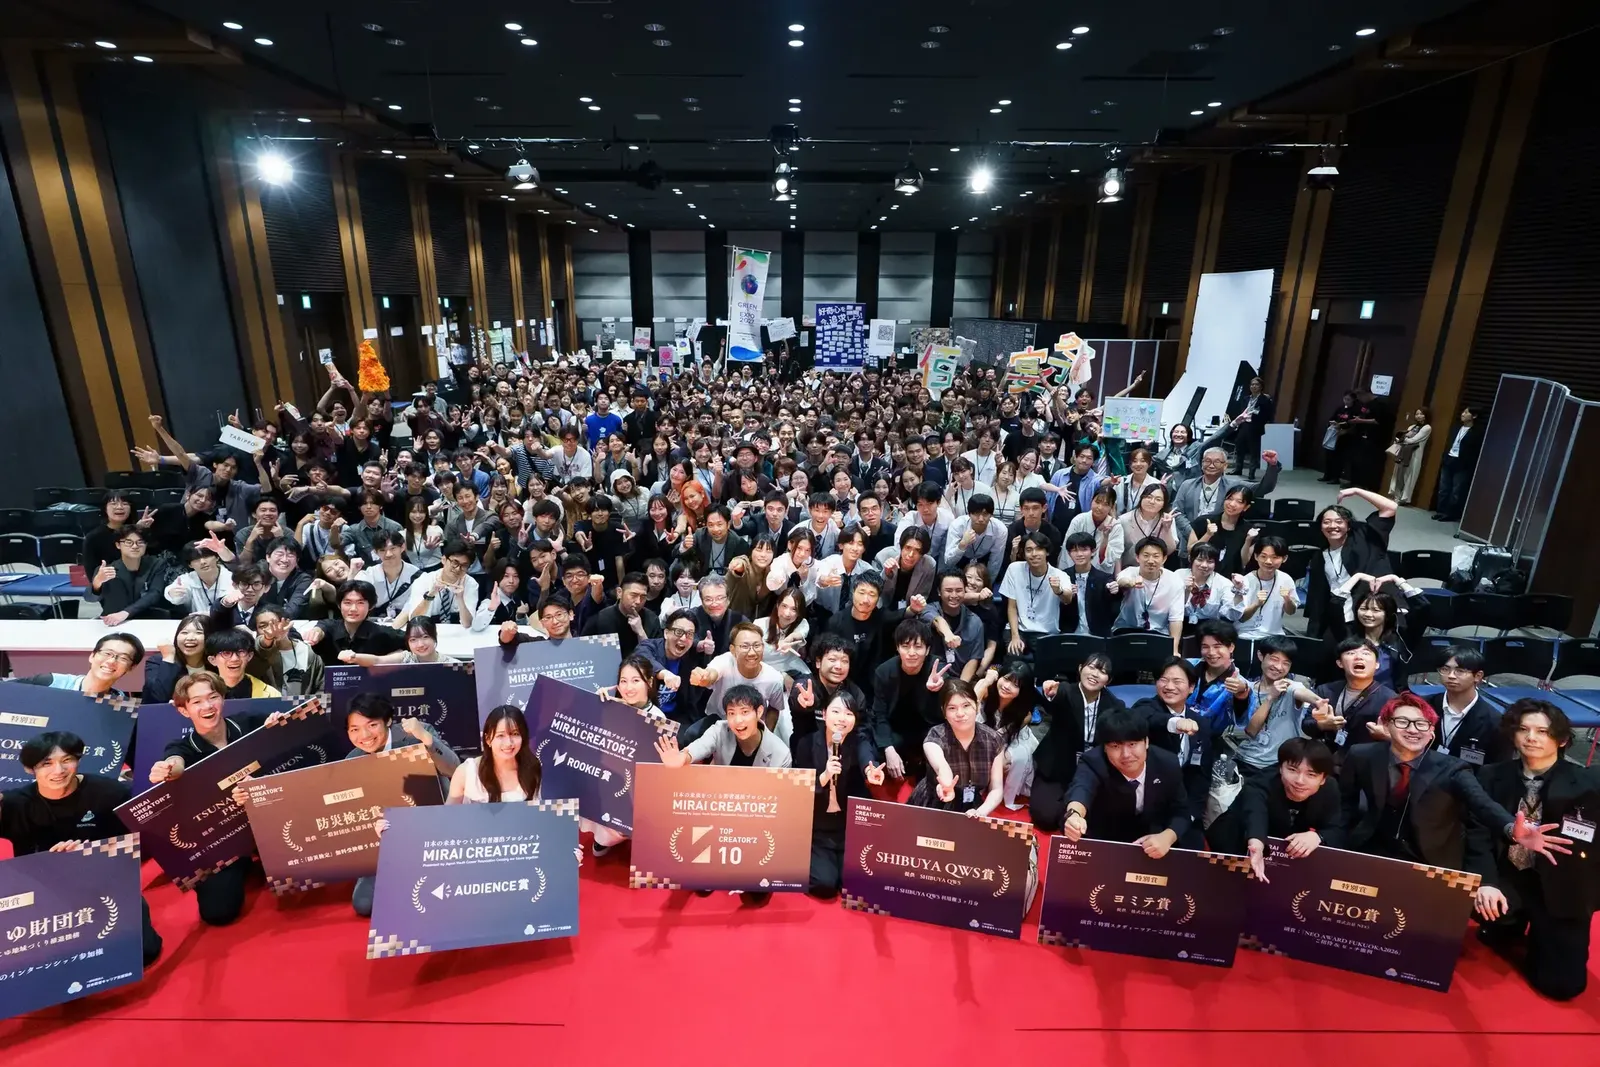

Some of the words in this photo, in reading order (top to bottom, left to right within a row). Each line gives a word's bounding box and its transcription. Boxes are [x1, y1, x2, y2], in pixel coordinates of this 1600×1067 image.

[508, 673, 538, 685] MIRAI
[393, 704, 430, 717] LP賞
[550, 718, 579, 737] MIRAI
[580, 729, 637, 759] CREATOR'Z
[193, 796, 234, 822] TSUNA
[270, 753, 304, 775] IPPON
[249, 784, 267, 792] MIRAI
[250, 786, 284, 798] CREATOR'Z
[252, 796, 267, 804] 2026
[332, 790, 355, 801] 特別賞
[129, 798, 151, 813] MIRAI
[132, 793, 172, 818] CREATOR'Z
[672, 800, 708, 811] MIRAI
[710, 800, 778, 814] CREATOR'Z
[136, 809, 153, 822] 2026
[315, 805, 383, 832] 防災検定賞
[855, 810, 886, 819] CREATOR'Z
[1566, 826, 1589, 836] STAFF
[718, 836, 758, 844] CREATOR'Z
[422, 847, 463, 862] MIRAI
[465, 842, 540, 859] CREATOR'Z
[718, 846, 742, 865] 10
[1058, 849, 1092, 857] CREATOR'Z
[875, 851, 941, 873] SHIBUYA
[919, 874, 946, 883] SHIBUYA
[1134, 874, 1159, 884] 特別賞
[1341, 883, 1367, 893] 特別賞
[1113, 894, 1172, 911] ヨミテ賞
[1317, 900, 1380, 923] NEO賞
[7, 907, 95, 942] ゆ財団賞
[1320, 934, 1348, 944] AWARD
